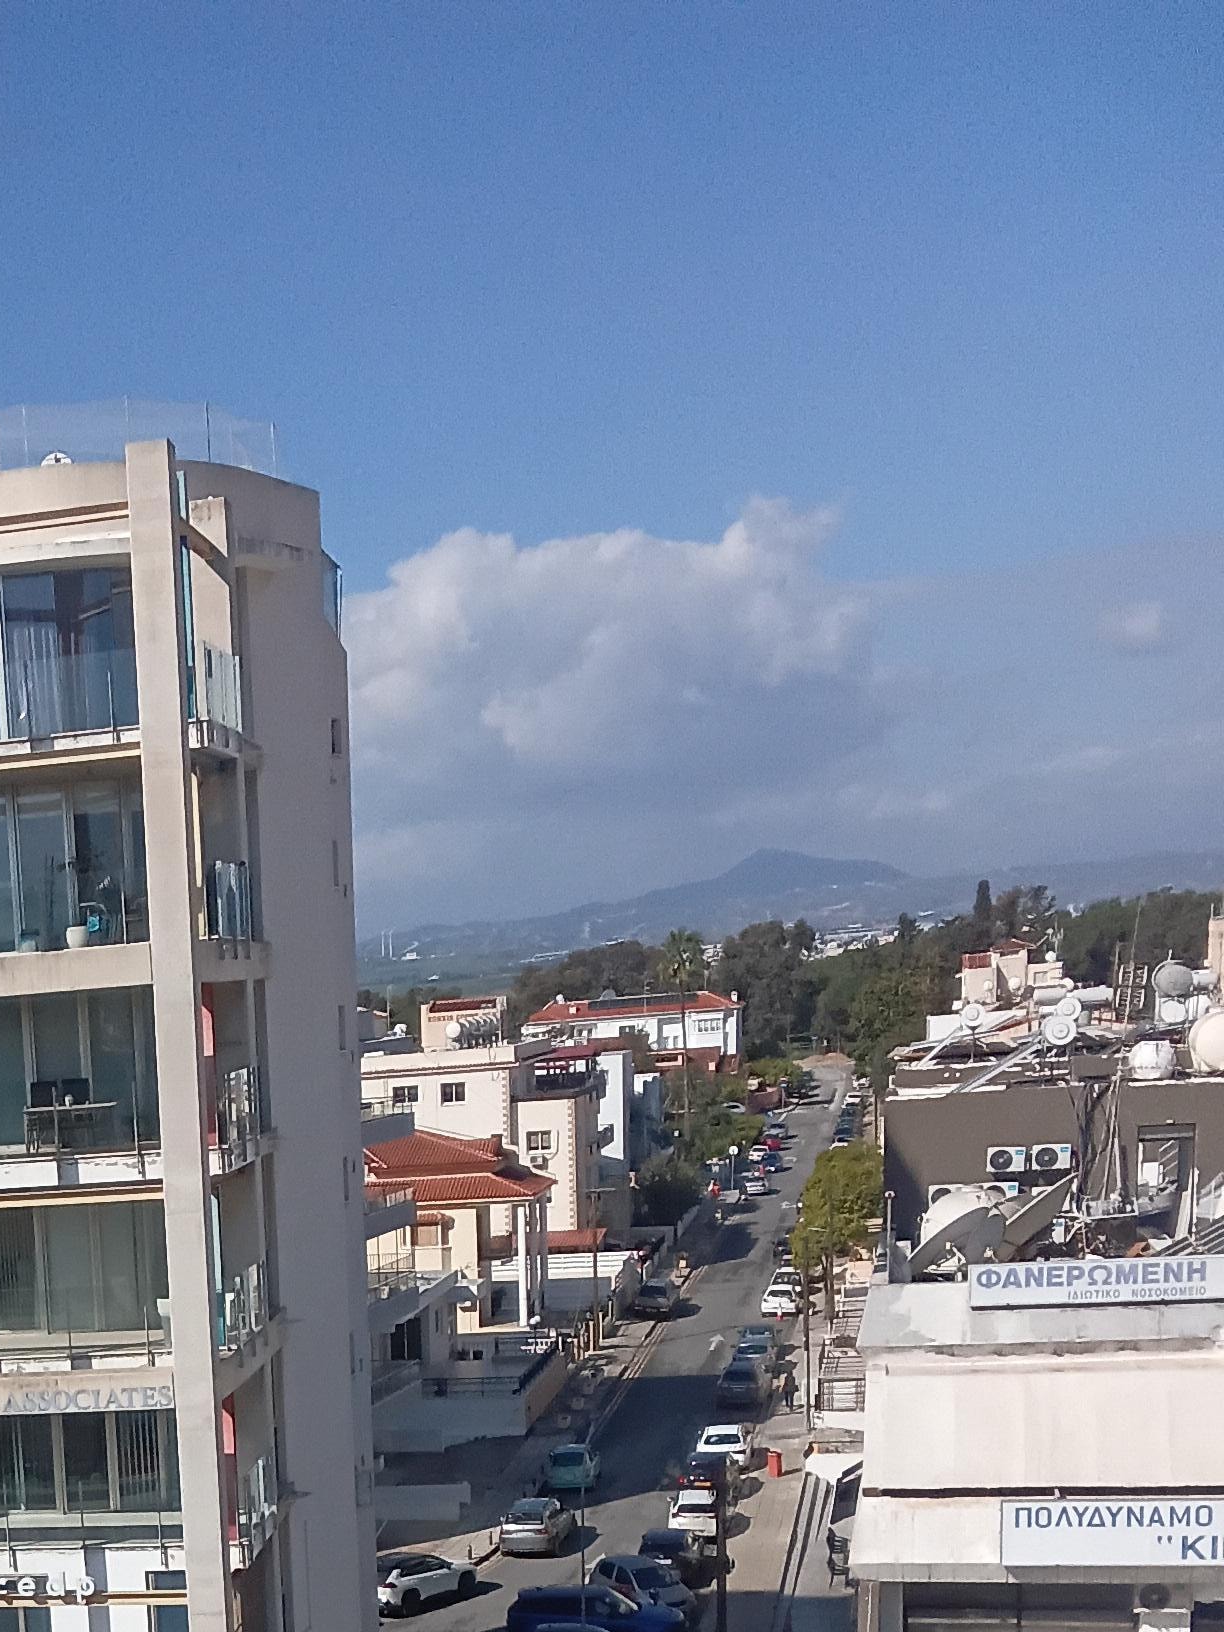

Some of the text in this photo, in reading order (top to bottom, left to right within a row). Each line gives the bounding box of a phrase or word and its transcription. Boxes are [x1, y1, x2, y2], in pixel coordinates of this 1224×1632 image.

[976, 1261, 1207, 1289] ΦΑΝΕΡΩΜΕΝΗ
[1131, 1286, 1207, 1299] ΝΟΣΟΚΟΜΕΙΟ
[2, 1386, 173, 1413] ASSOCIATES
[1014, 1504, 1213, 1528] ΠΟΛΥΔΥΝΑΜΟ
